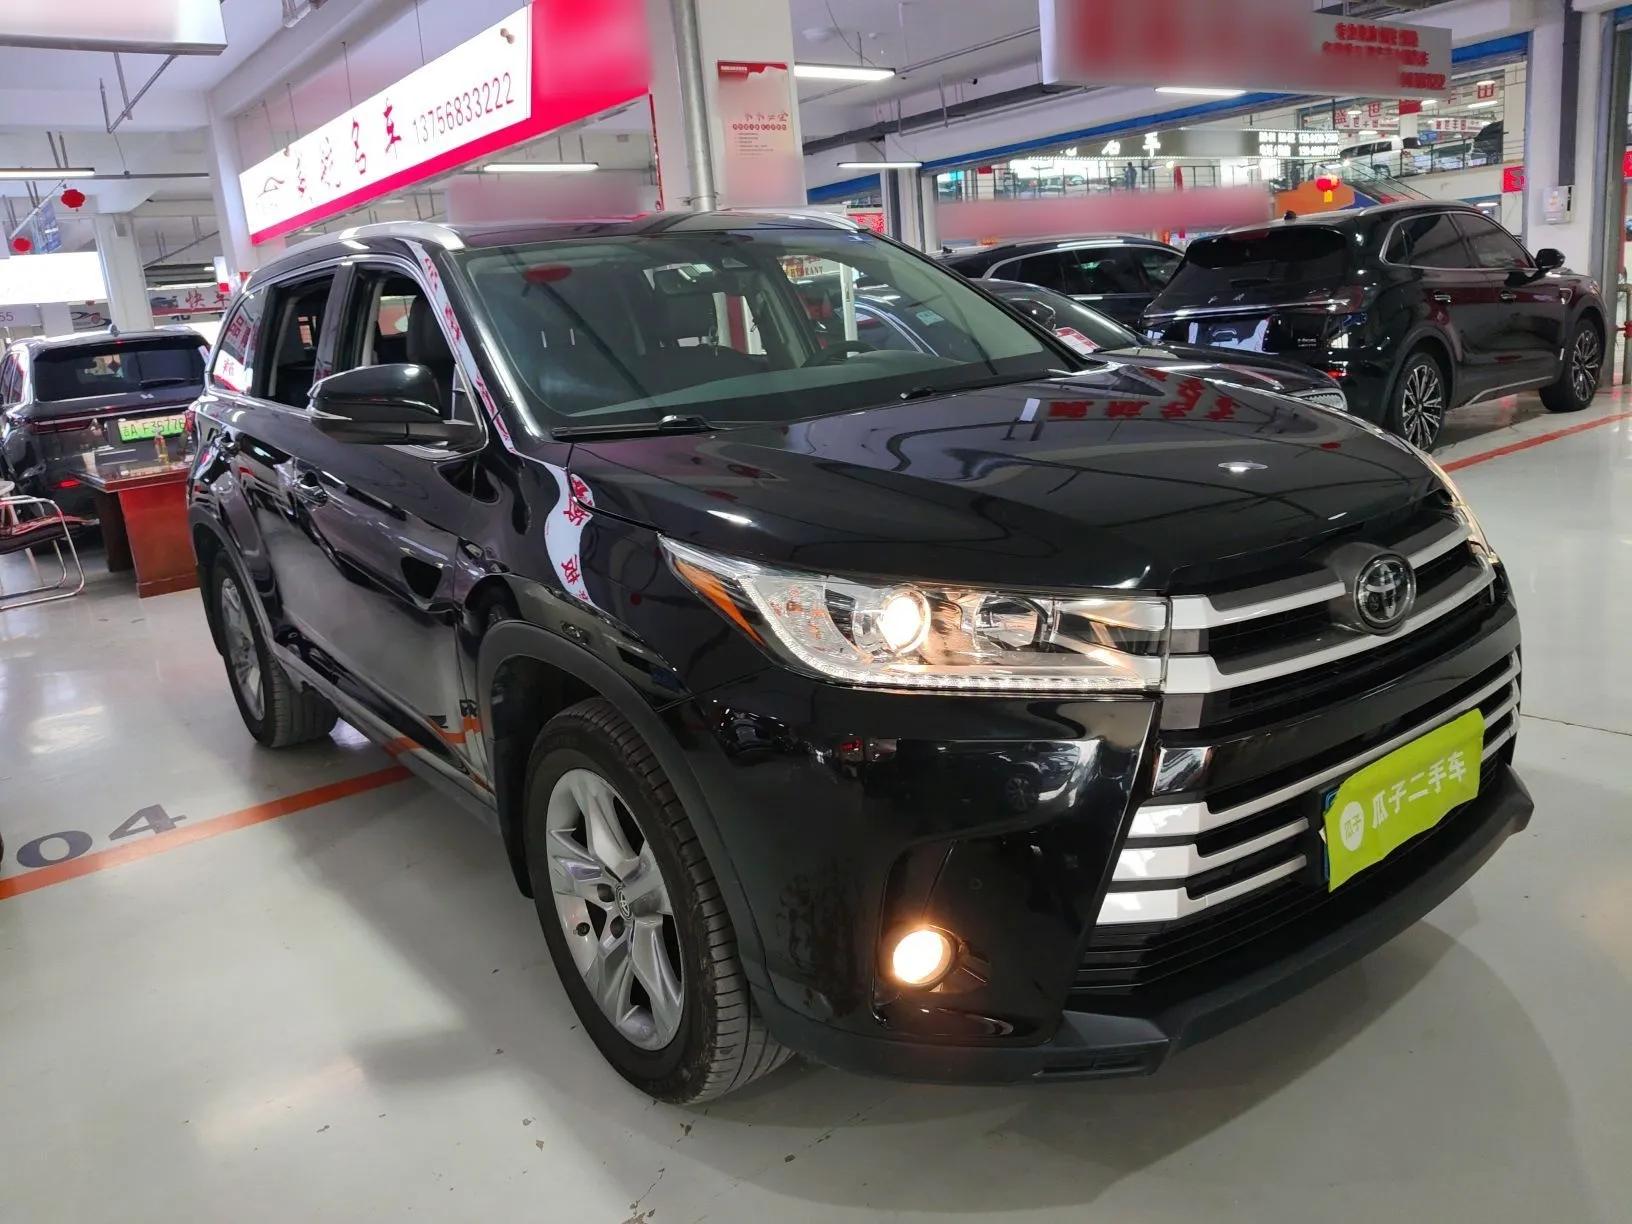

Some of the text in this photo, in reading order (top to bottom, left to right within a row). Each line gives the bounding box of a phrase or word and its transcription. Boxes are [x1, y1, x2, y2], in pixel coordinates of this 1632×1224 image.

[412, 72, 514, 144] 13756833222
[1372, 751, 1466, 829] 瓜子二手车
[16, 804, 187, 868] 04
